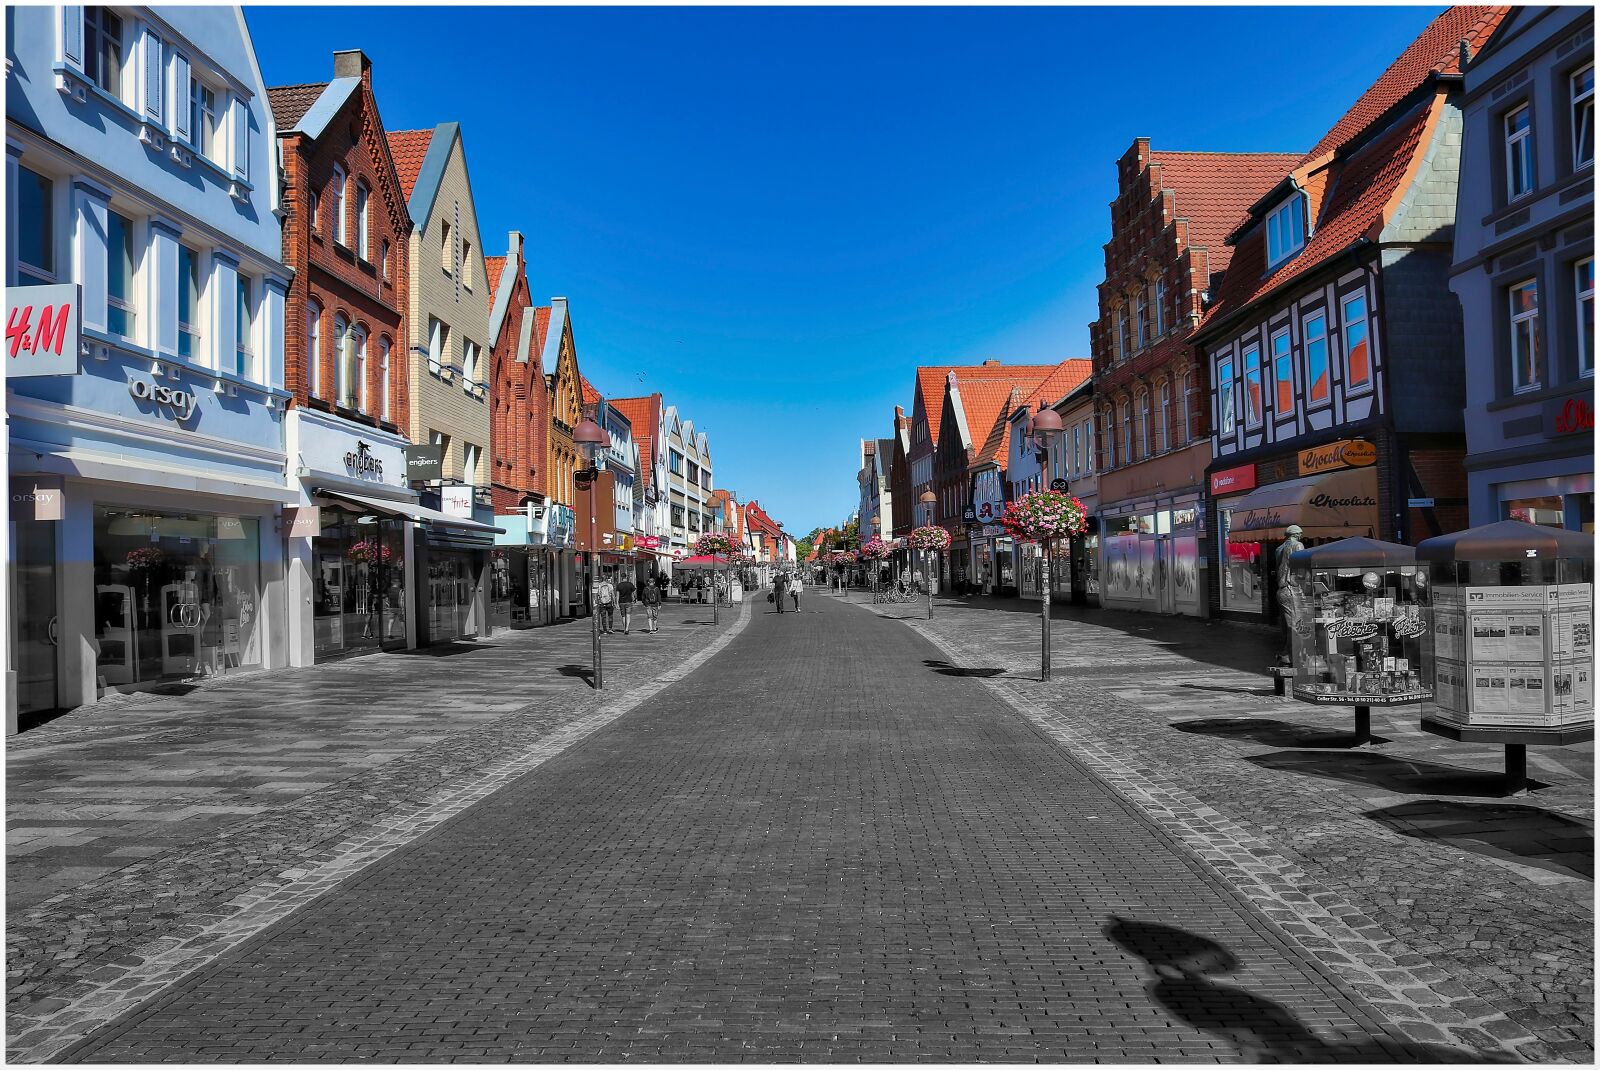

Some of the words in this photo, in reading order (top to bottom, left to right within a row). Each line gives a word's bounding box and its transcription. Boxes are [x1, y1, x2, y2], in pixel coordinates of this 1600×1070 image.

[5, 303, 71, 359] H&M
[132, 380, 197, 421] orsay
[345, 449, 383, 474] engbers
[408, 458, 438, 467] engbers
[12, 494, 54, 506] orsay
[1309, 493, 1377, 508] Chocolata
[286, 518, 314, 528] orsay
[1243, 509, 1281, 528] Chocolata
